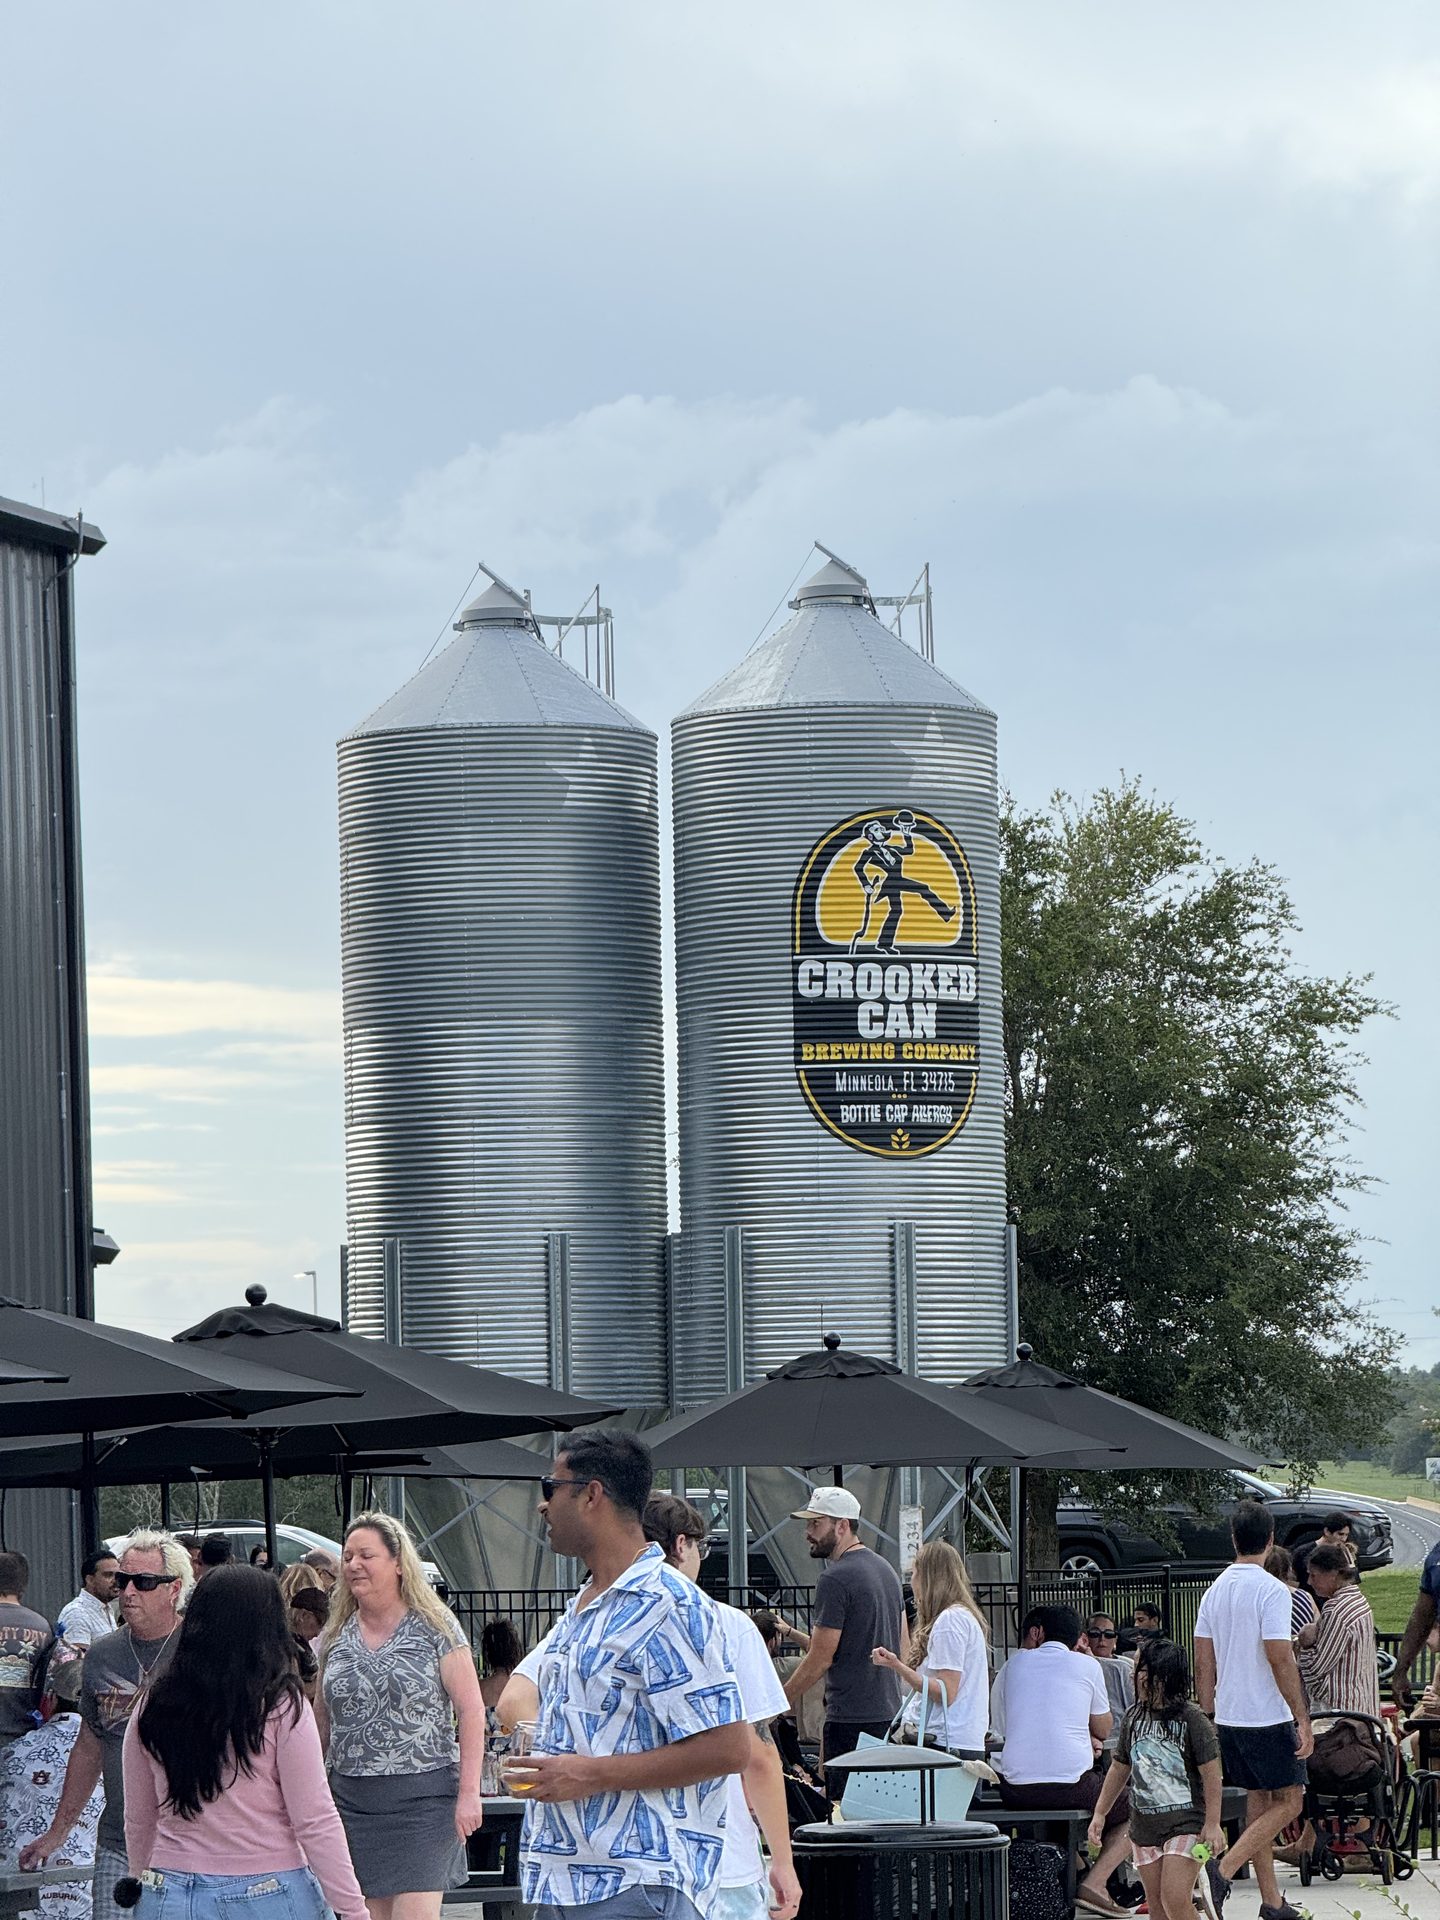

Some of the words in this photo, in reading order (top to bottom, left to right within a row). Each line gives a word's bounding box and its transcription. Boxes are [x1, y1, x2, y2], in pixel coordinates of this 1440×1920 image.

[798, 959, 976, 1002] CROOKED
[857, 1001, 938, 1039] CAN
[801, 1043, 895, 1061] BREWING
[902, 1043, 976, 1061] COMPANY
[903, 1072, 917, 1092] FL
[921, 1071, 955, 1092] 34715
[840, 1104, 881, 1124] BOTTLE
[885, 1104, 908, 1123] CAP
[912, 1105, 953, 1124] ALLERGY
[23, 1628, 48, 1649] DAY
[40, 1892, 78, 1901] AUBURN
